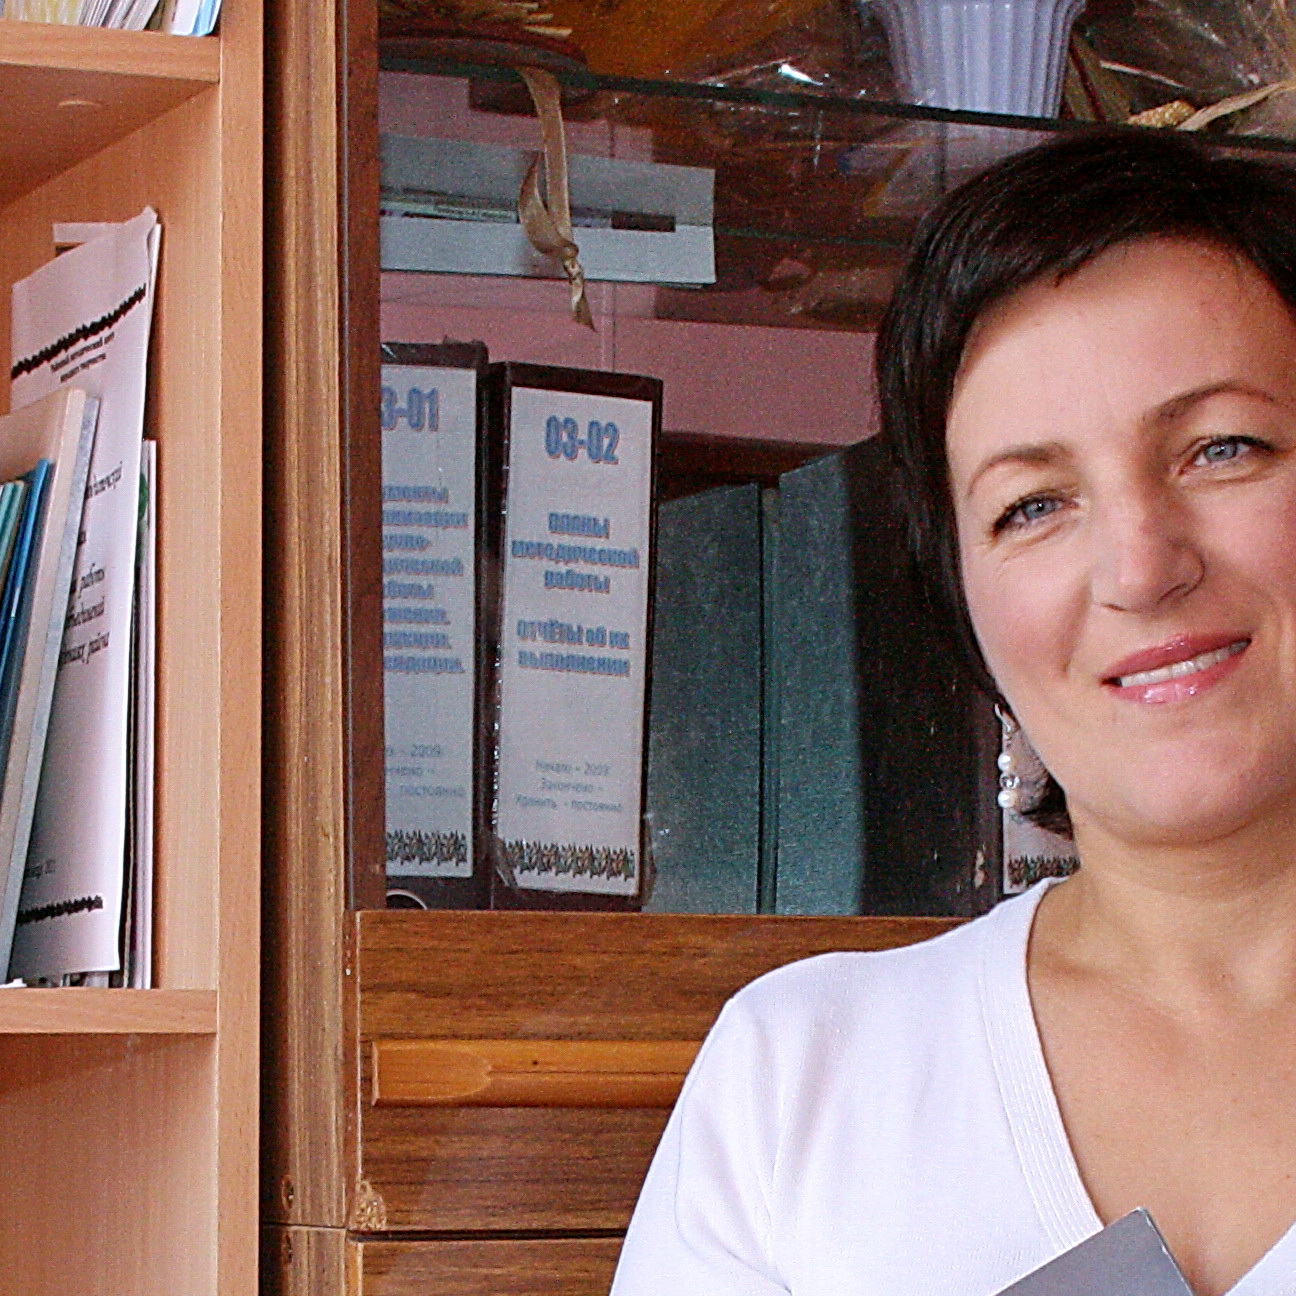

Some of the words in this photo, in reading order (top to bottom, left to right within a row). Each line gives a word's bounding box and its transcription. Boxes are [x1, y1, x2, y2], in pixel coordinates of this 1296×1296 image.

[381, 386, 439, 431] 3-01
[544, 415, 620, 465] 03-02
[548, 512, 611, 539] планы
[544, 568, 611, 594] работы
[585, 625, 607, 648] об
